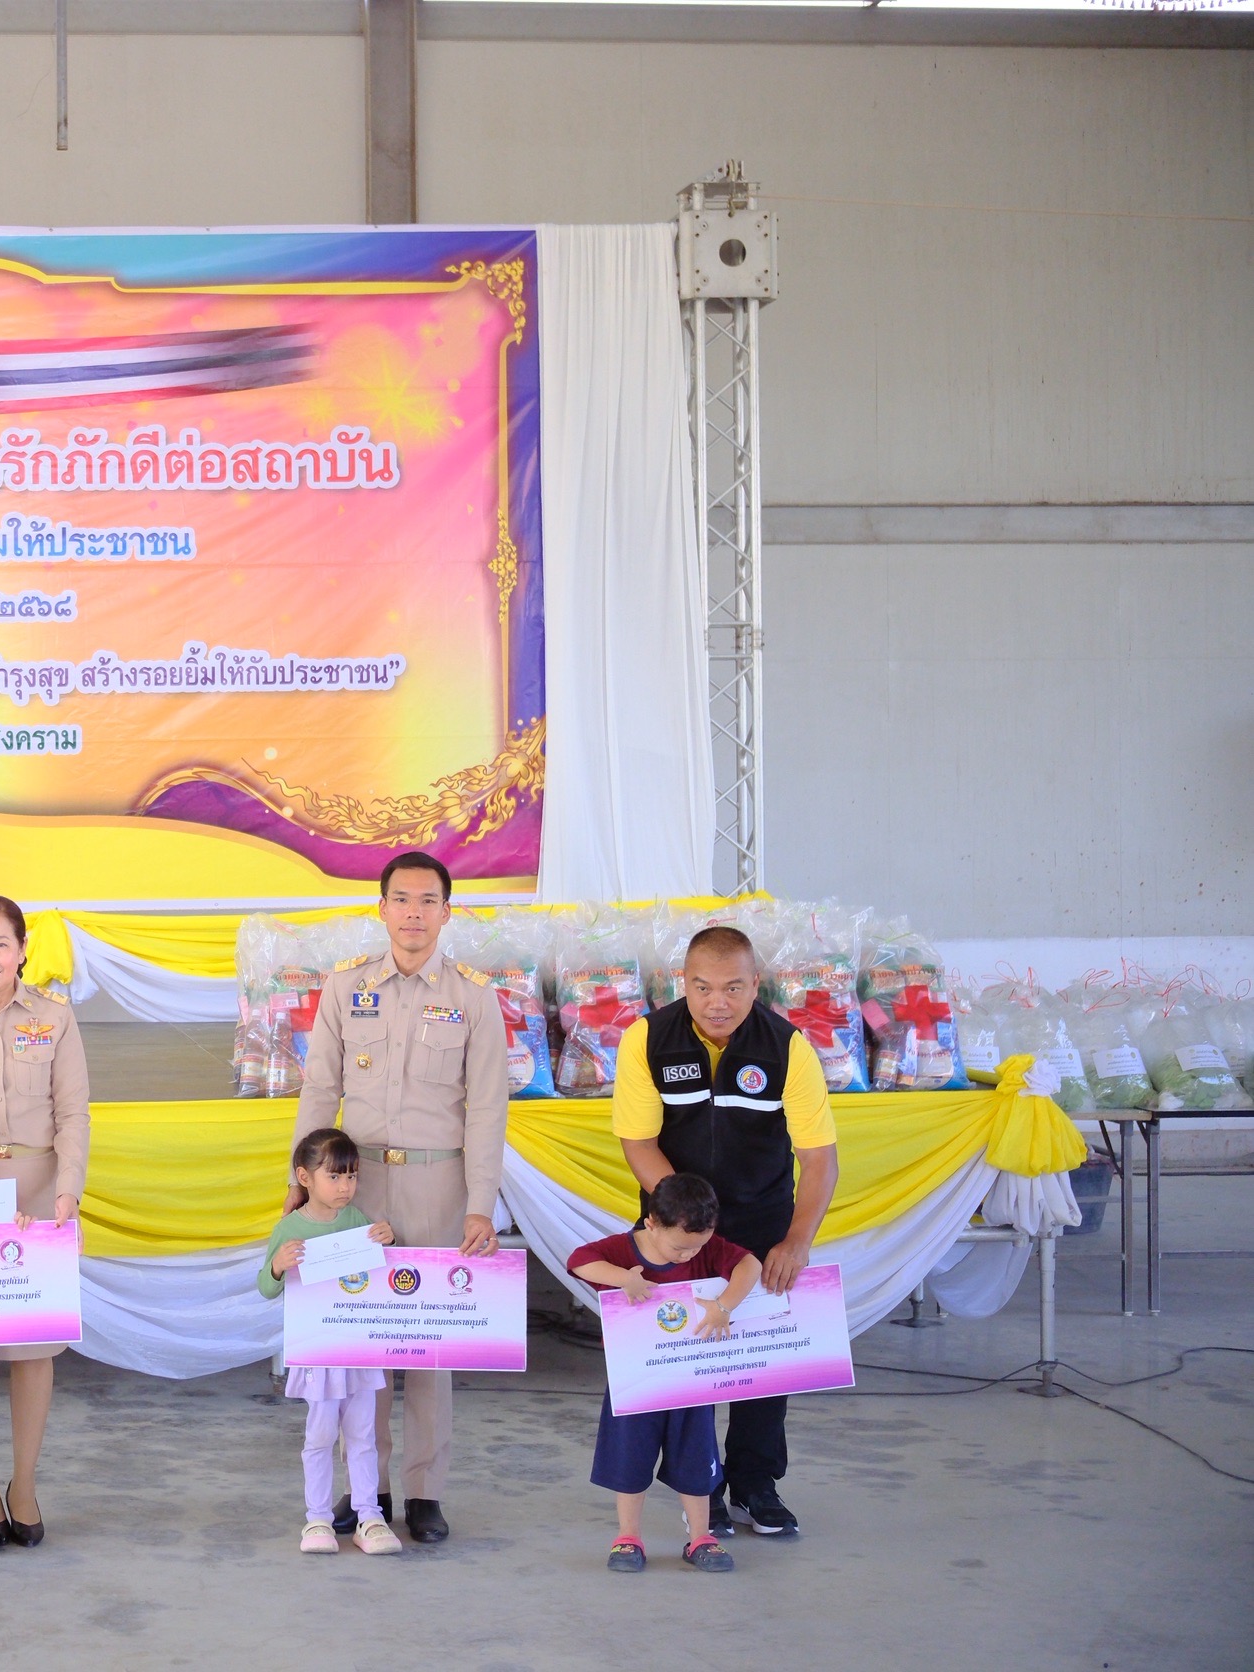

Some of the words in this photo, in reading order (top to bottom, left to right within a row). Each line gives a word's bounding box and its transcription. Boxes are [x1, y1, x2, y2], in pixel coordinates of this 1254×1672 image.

[81, 646, 400, 688] สร้างรอยยิ้มให้กับประชาชน”
[666, 1065, 699, 1081] ISOC
